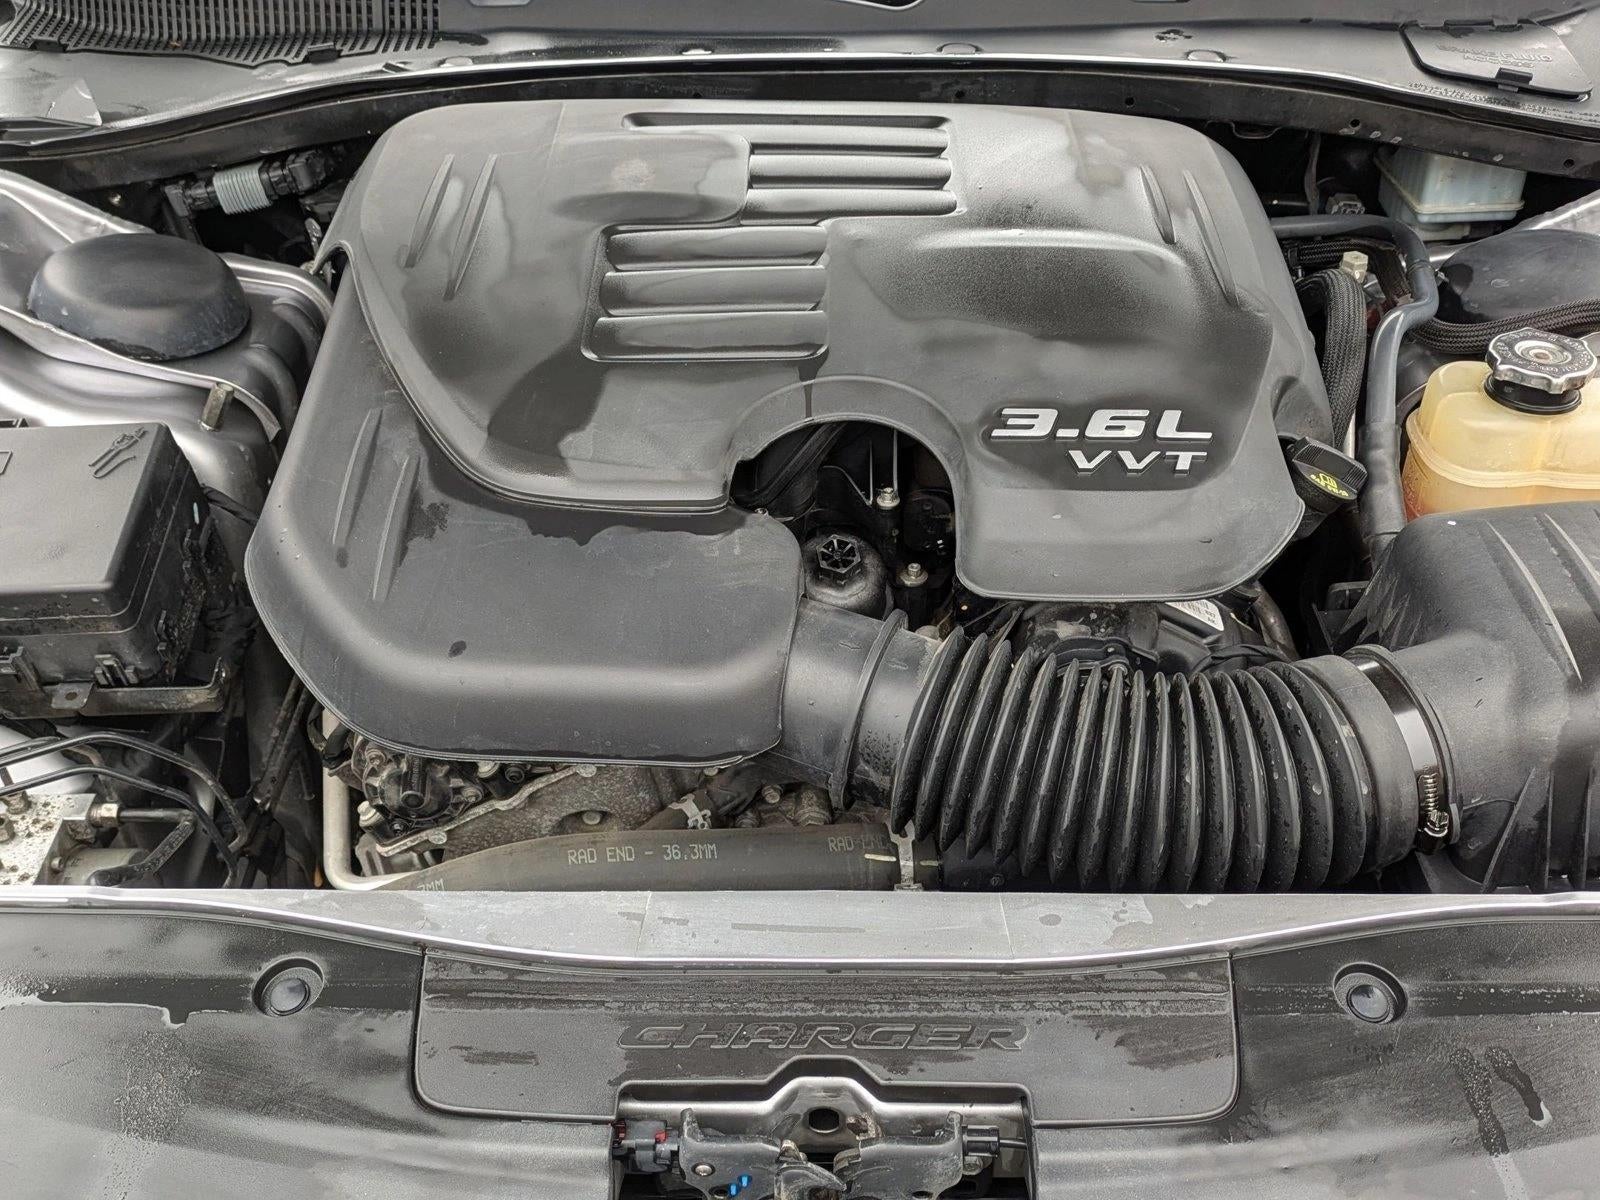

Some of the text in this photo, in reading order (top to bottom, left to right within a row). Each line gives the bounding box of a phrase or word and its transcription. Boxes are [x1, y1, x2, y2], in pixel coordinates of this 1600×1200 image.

[1501, 48, 1553, 62] FLUID
[990, 407, 1213, 440] 3.6L
[1067, 449, 1208, 474] VVT
[567, 848, 598, 865] RAD
[606, 845, 636, 863] END
[661, 843, 718, 861] 36.3MM
[828, 836, 854, 851] RAD
[617, 1022, 1031, 1050] CHARGER
